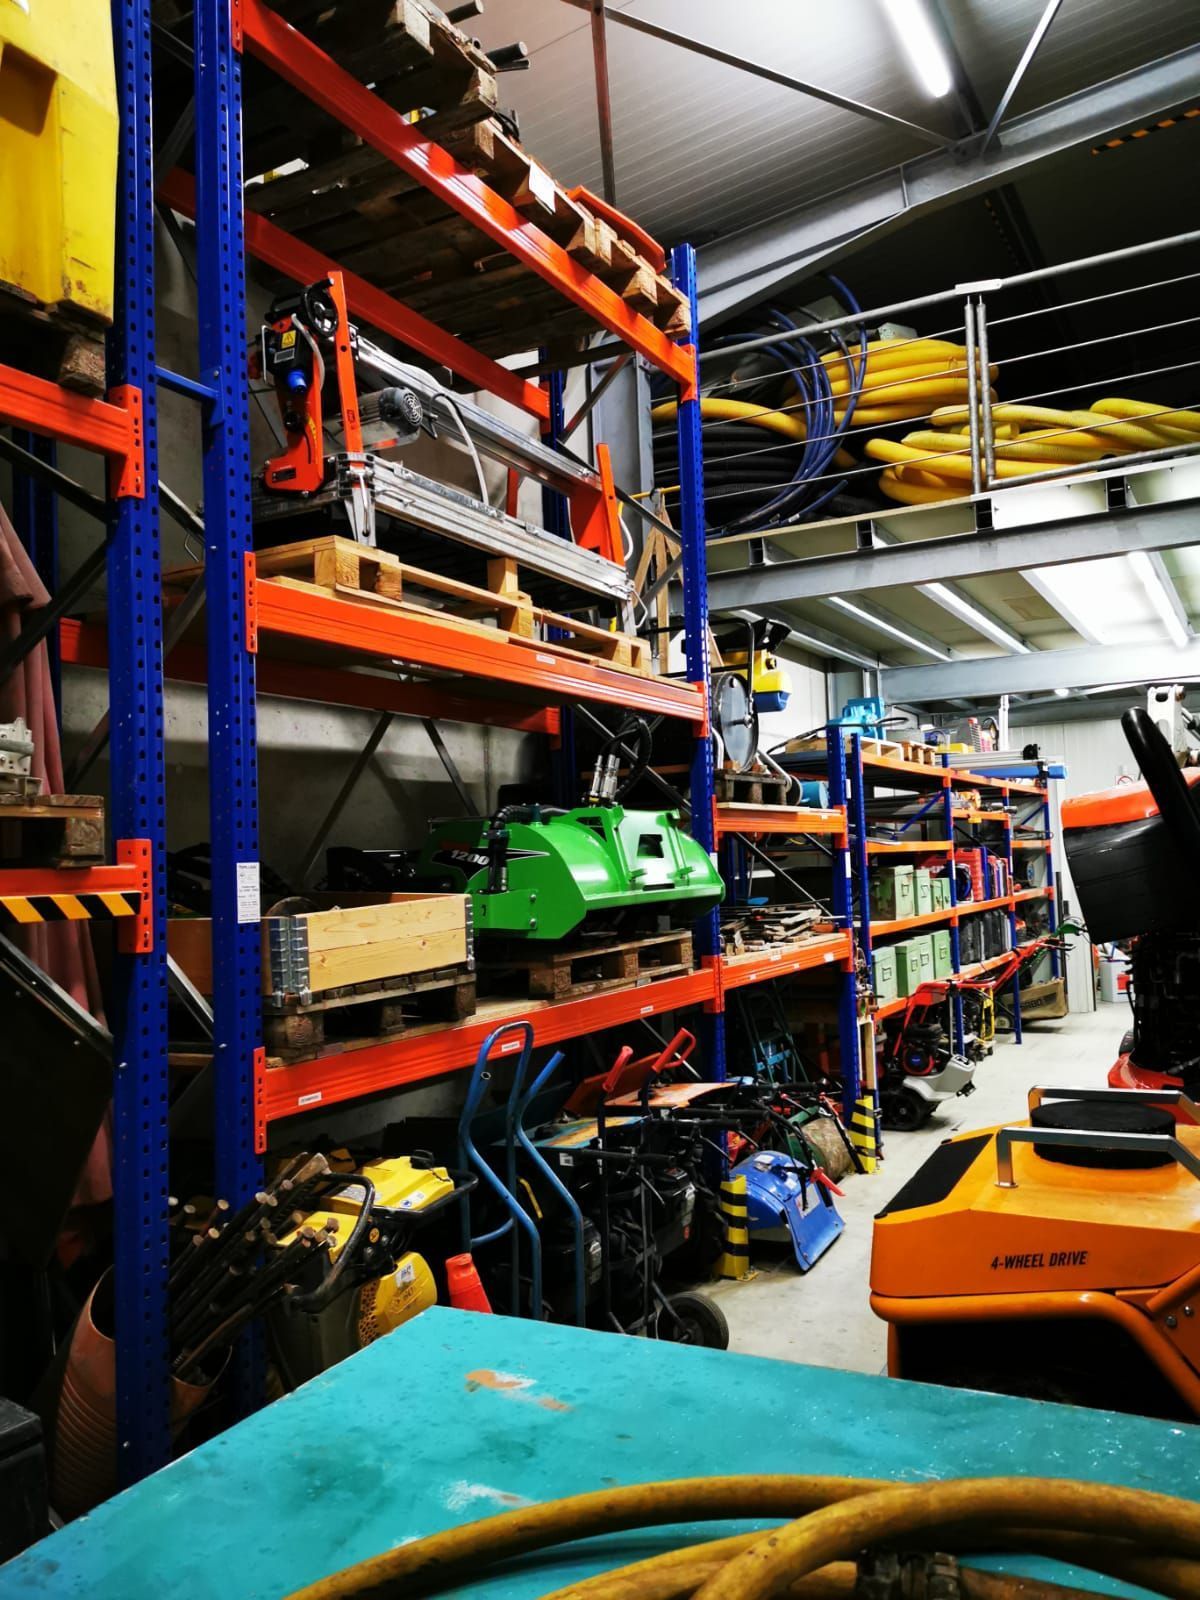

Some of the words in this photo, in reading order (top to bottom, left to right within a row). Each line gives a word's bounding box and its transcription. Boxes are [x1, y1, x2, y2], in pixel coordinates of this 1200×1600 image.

[451, 849, 490, 865] 1200
[990, 1253, 1045, 1270] 4-WHEEL
[1048, 1250, 1088, 1267] DRIVE
